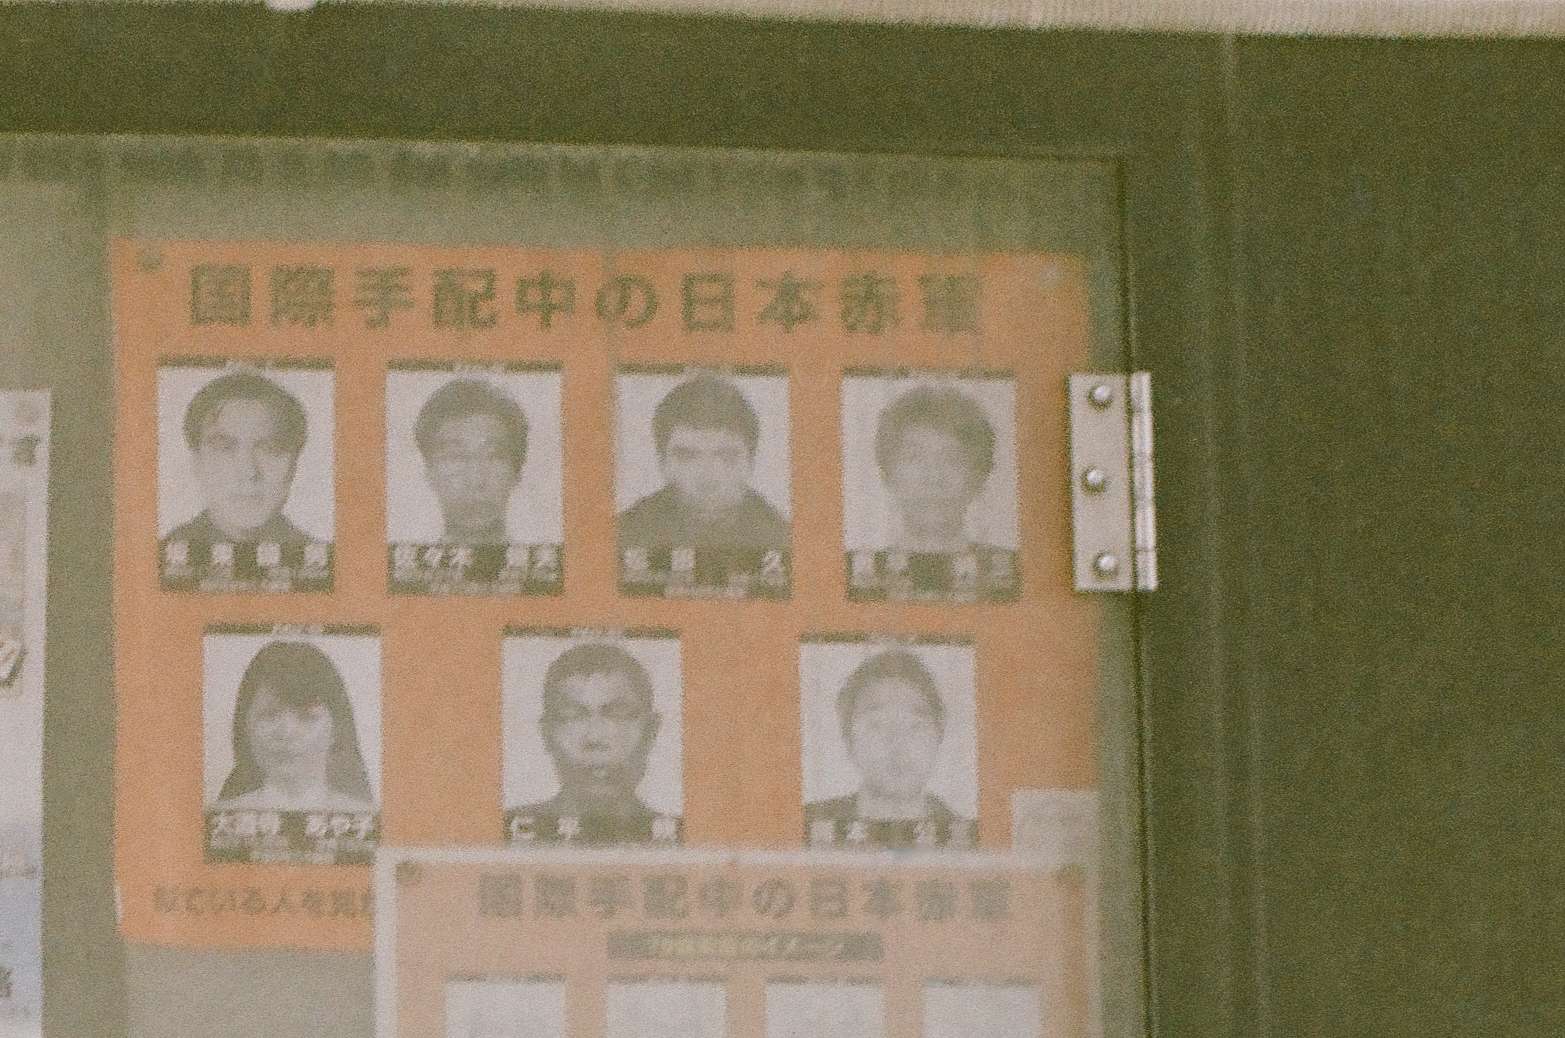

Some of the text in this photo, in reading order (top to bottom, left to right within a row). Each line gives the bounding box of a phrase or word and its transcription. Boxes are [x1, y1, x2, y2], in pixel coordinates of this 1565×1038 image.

[190, 264, 981, 334] 国際手配中の日本赤軍
